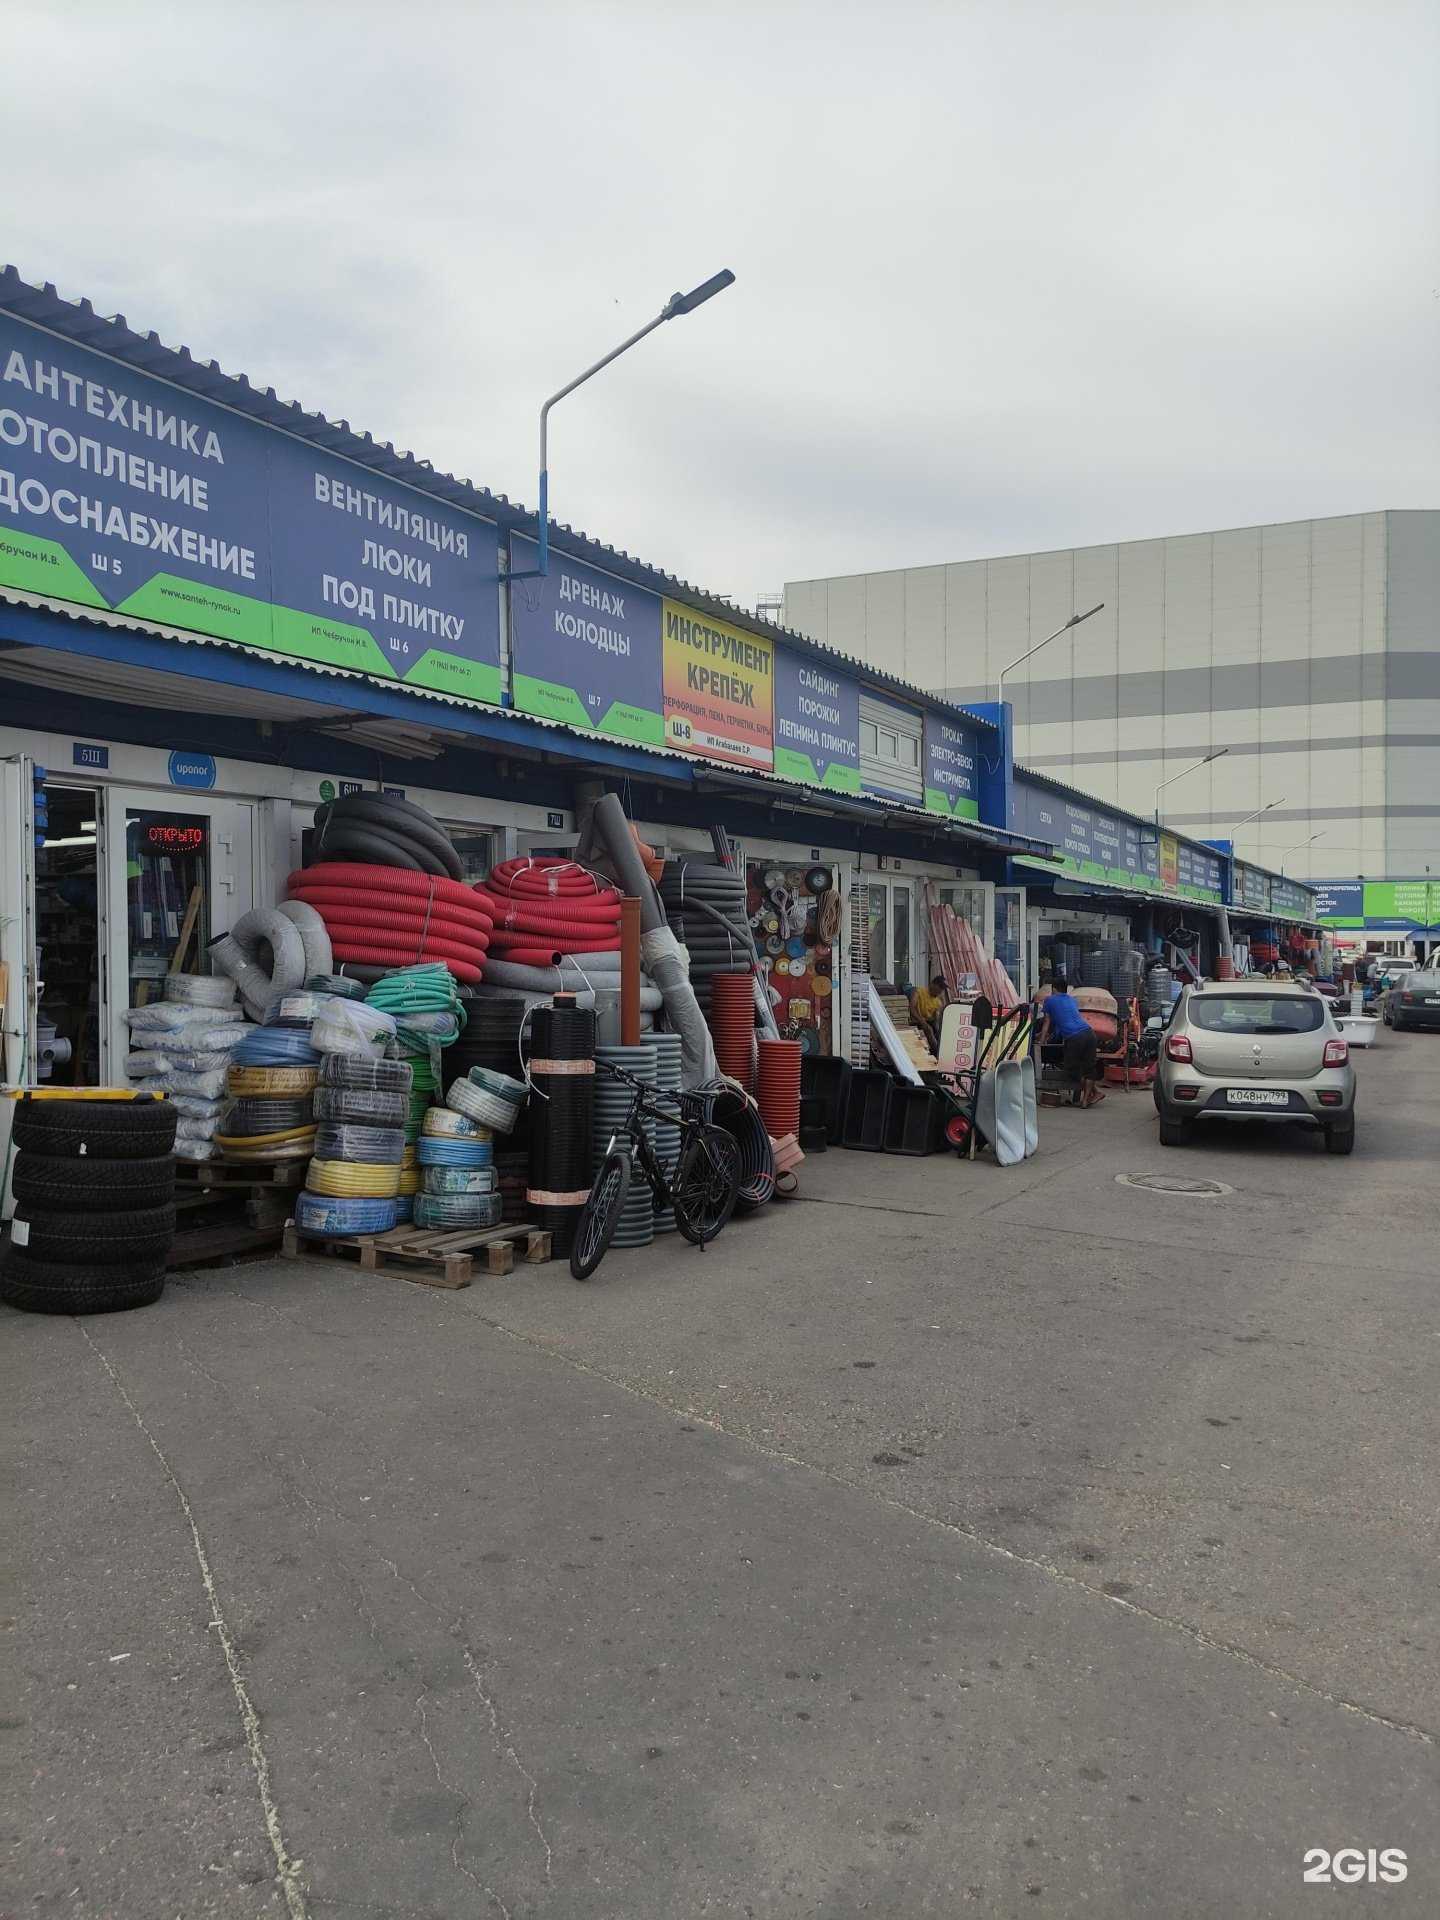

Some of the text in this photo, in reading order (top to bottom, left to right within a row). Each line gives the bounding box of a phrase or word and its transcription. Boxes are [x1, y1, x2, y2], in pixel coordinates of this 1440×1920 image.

[3, 350, 225, 465] АНТЕХНИКА
[0, 408, 209, 512] ОТОПЛЕНИЕ
[314, 472, 469, 559] ВЕНТИЛЯЦИЯ
[92, 552, 123, 576] Ш 5
[361, 539, 432, 588] ЛЮКИ
[322, 574, 465, 641] ПОД ПЛИТКУ
[558, 574, 626, 619] ДРЕНАЖ
[389, 637, 409, 654] Ш 6
[554, 610, 631, 657] КОЛОДЦЫ
[666, 611, 771, 675] ИНСТРУМЕНТ
[588, 693, 596, 706] Ш
[596, 696, 601, 707] 7
[687, 662, 756, 708] КРЕПЁЖ
[798, 668, 840, 698] САЙДИНГ
[798, 696, 840, 726] ПОРОЖКИ
[672, 721, 691, 740] Ш-8
[778, 718, 857, 759] ЛЕПНИНА ПЛИНТУС
[941, 725, 964, 745] ПРОКАТ
[176, 763, 209, 777] uponor
[149, 827, 202, 843] ОТКРЫТО
[1270, 1091, 1286, 1099] 799
